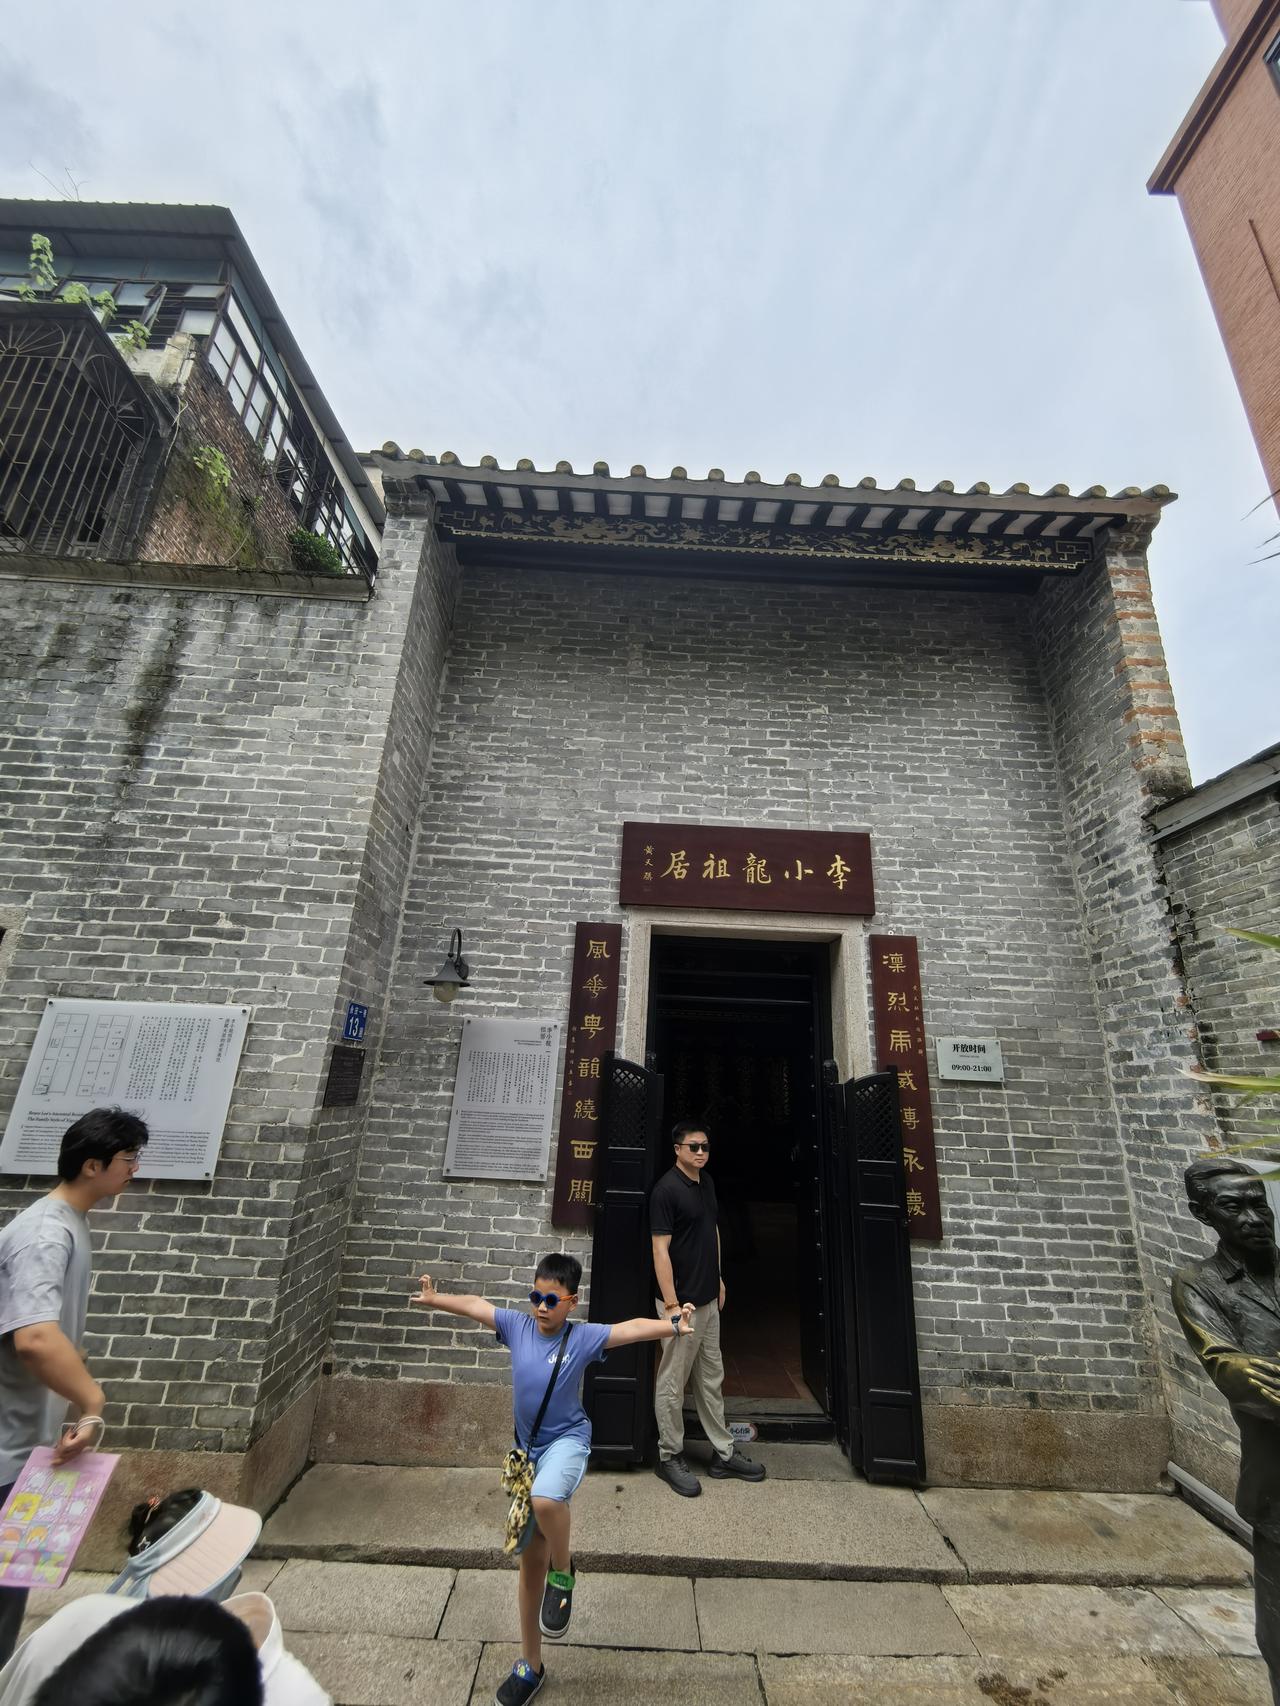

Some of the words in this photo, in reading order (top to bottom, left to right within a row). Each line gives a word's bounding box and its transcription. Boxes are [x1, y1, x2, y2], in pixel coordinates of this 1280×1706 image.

[660, 850, 851, 890] 李小龍祖居
[349, 1016, 359, 1037] 13
[952, 1043, 986, 1054] 开放时间
[951, 1064, 992, 1072] 09:00-21:00
